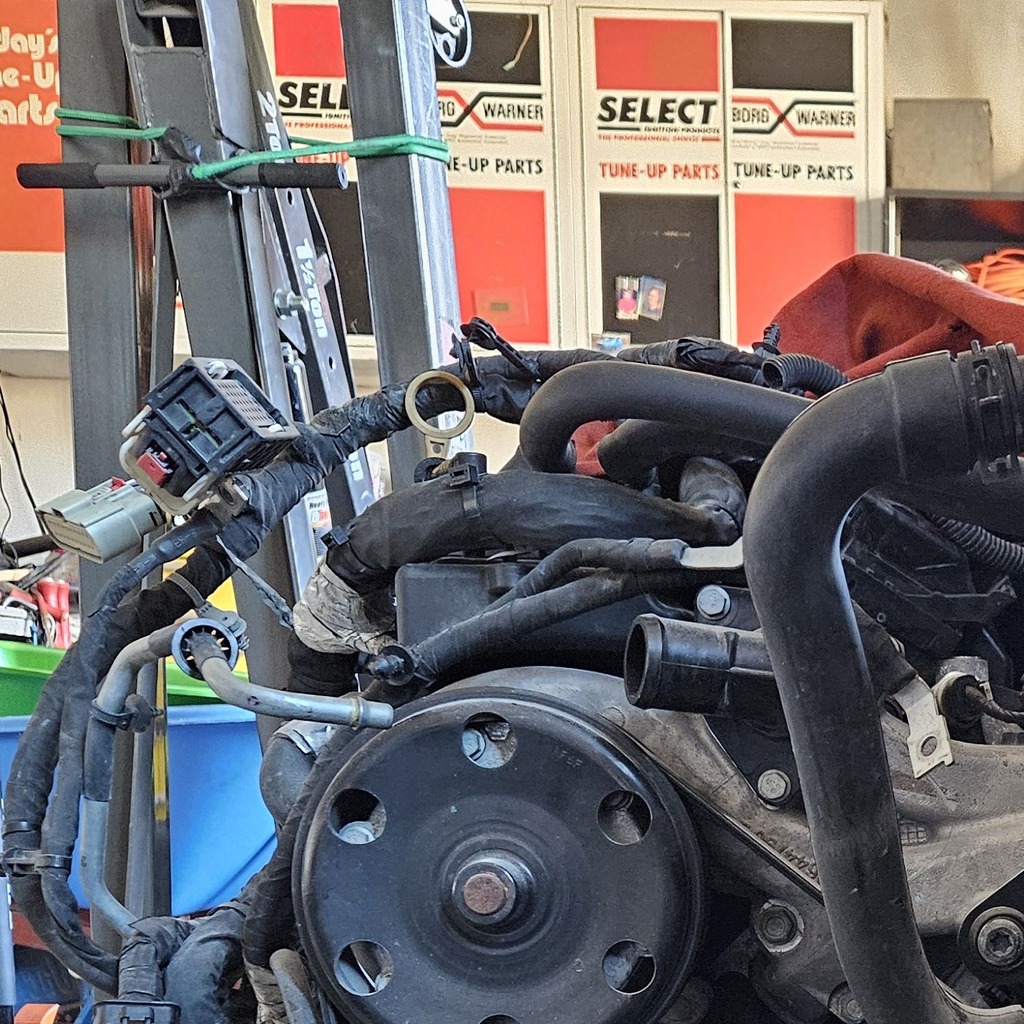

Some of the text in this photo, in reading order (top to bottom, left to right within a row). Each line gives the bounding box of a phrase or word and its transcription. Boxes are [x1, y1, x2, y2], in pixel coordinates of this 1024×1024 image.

[483, 102, 544, 120] WARNER
[598, 96, 717, 125] SELECT
[796, 108, 856, 127] WARNER
[495, 157, 544, 175] PARTS
[599, 162, 720, 180] TUNE-UP PARTS
[733, 162, 855, 181] TUNE-UP PARTS
